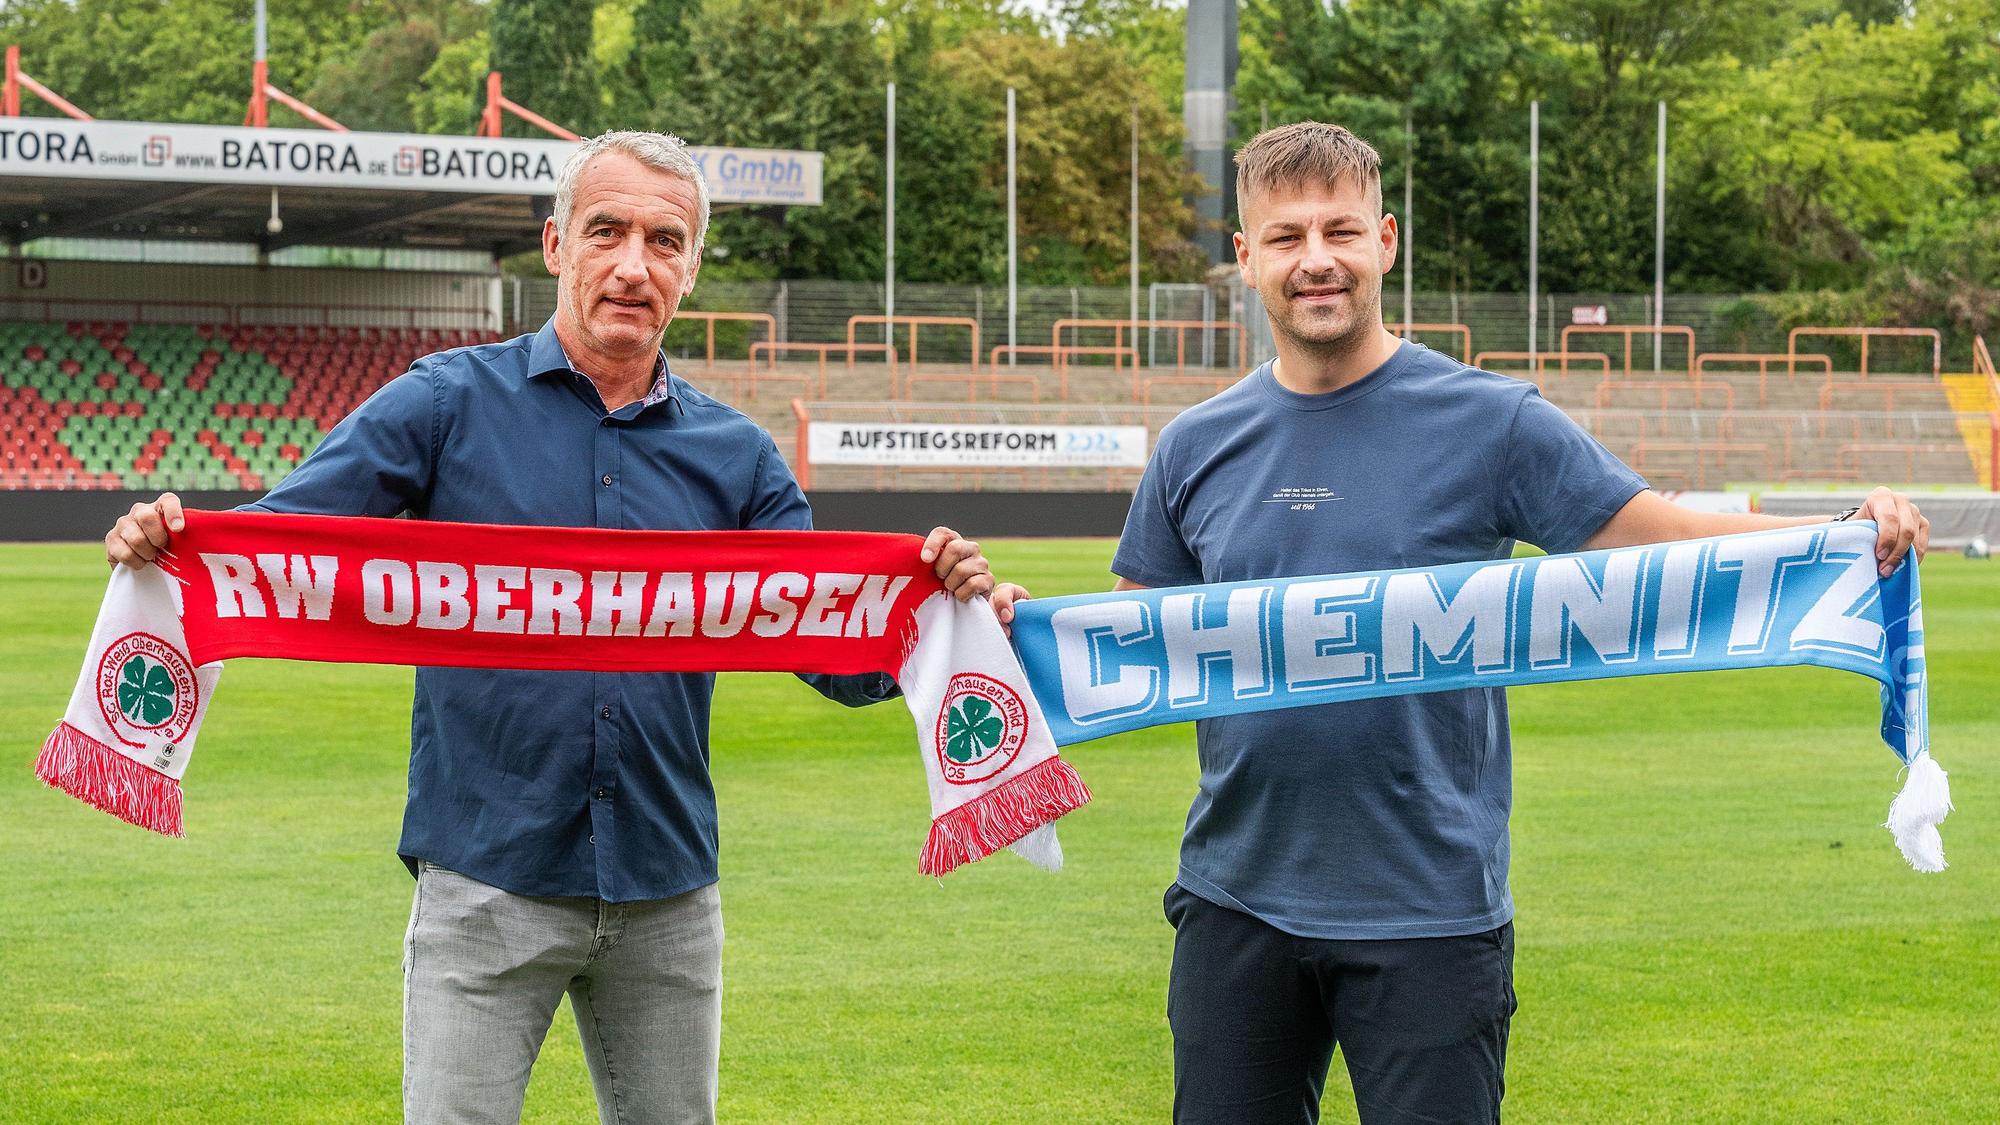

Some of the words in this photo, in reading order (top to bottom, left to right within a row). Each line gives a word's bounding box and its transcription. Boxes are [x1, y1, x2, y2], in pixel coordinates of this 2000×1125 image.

[223, 140, 361, 174] BATORA
[422, 148, 555, 181] BATORA
[719, 153, 803, 185] Gmbh
[840, 430, 1057, 450] AUFSTIEGSREFORM
[198, 552, 340, 621] RW
[361, 558, 913, 638] OBERHAUSEN
[1050, 525, 1886, 726] CHEMNITZ
[106, 702, 121, 725] SC
[947, 766, 966, 779] SC
